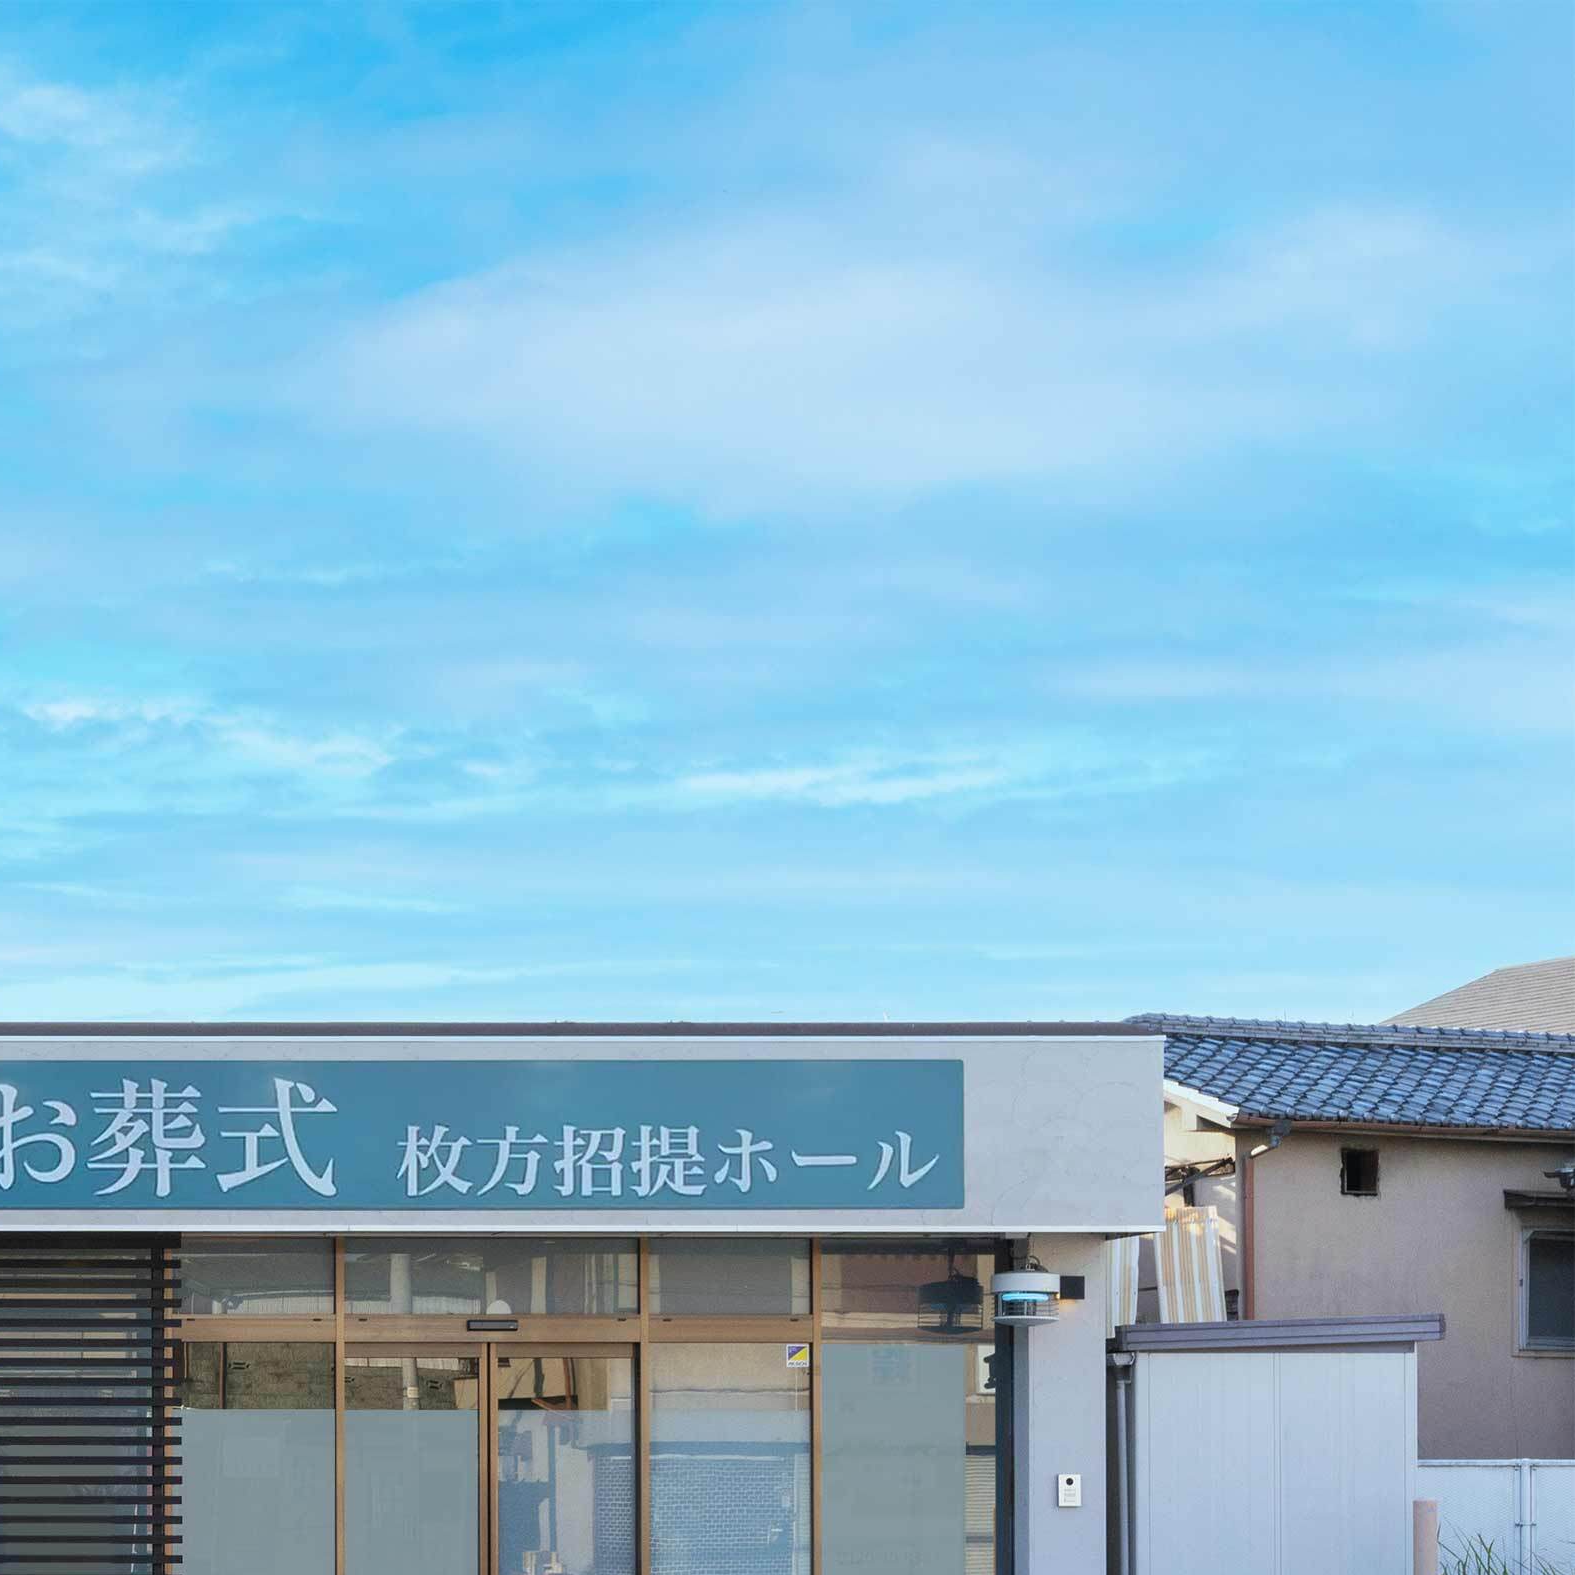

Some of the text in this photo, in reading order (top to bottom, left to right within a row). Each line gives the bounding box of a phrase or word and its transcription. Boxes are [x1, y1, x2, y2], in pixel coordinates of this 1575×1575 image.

[397, 1125, 939, 1196] 枚方招提ホール
